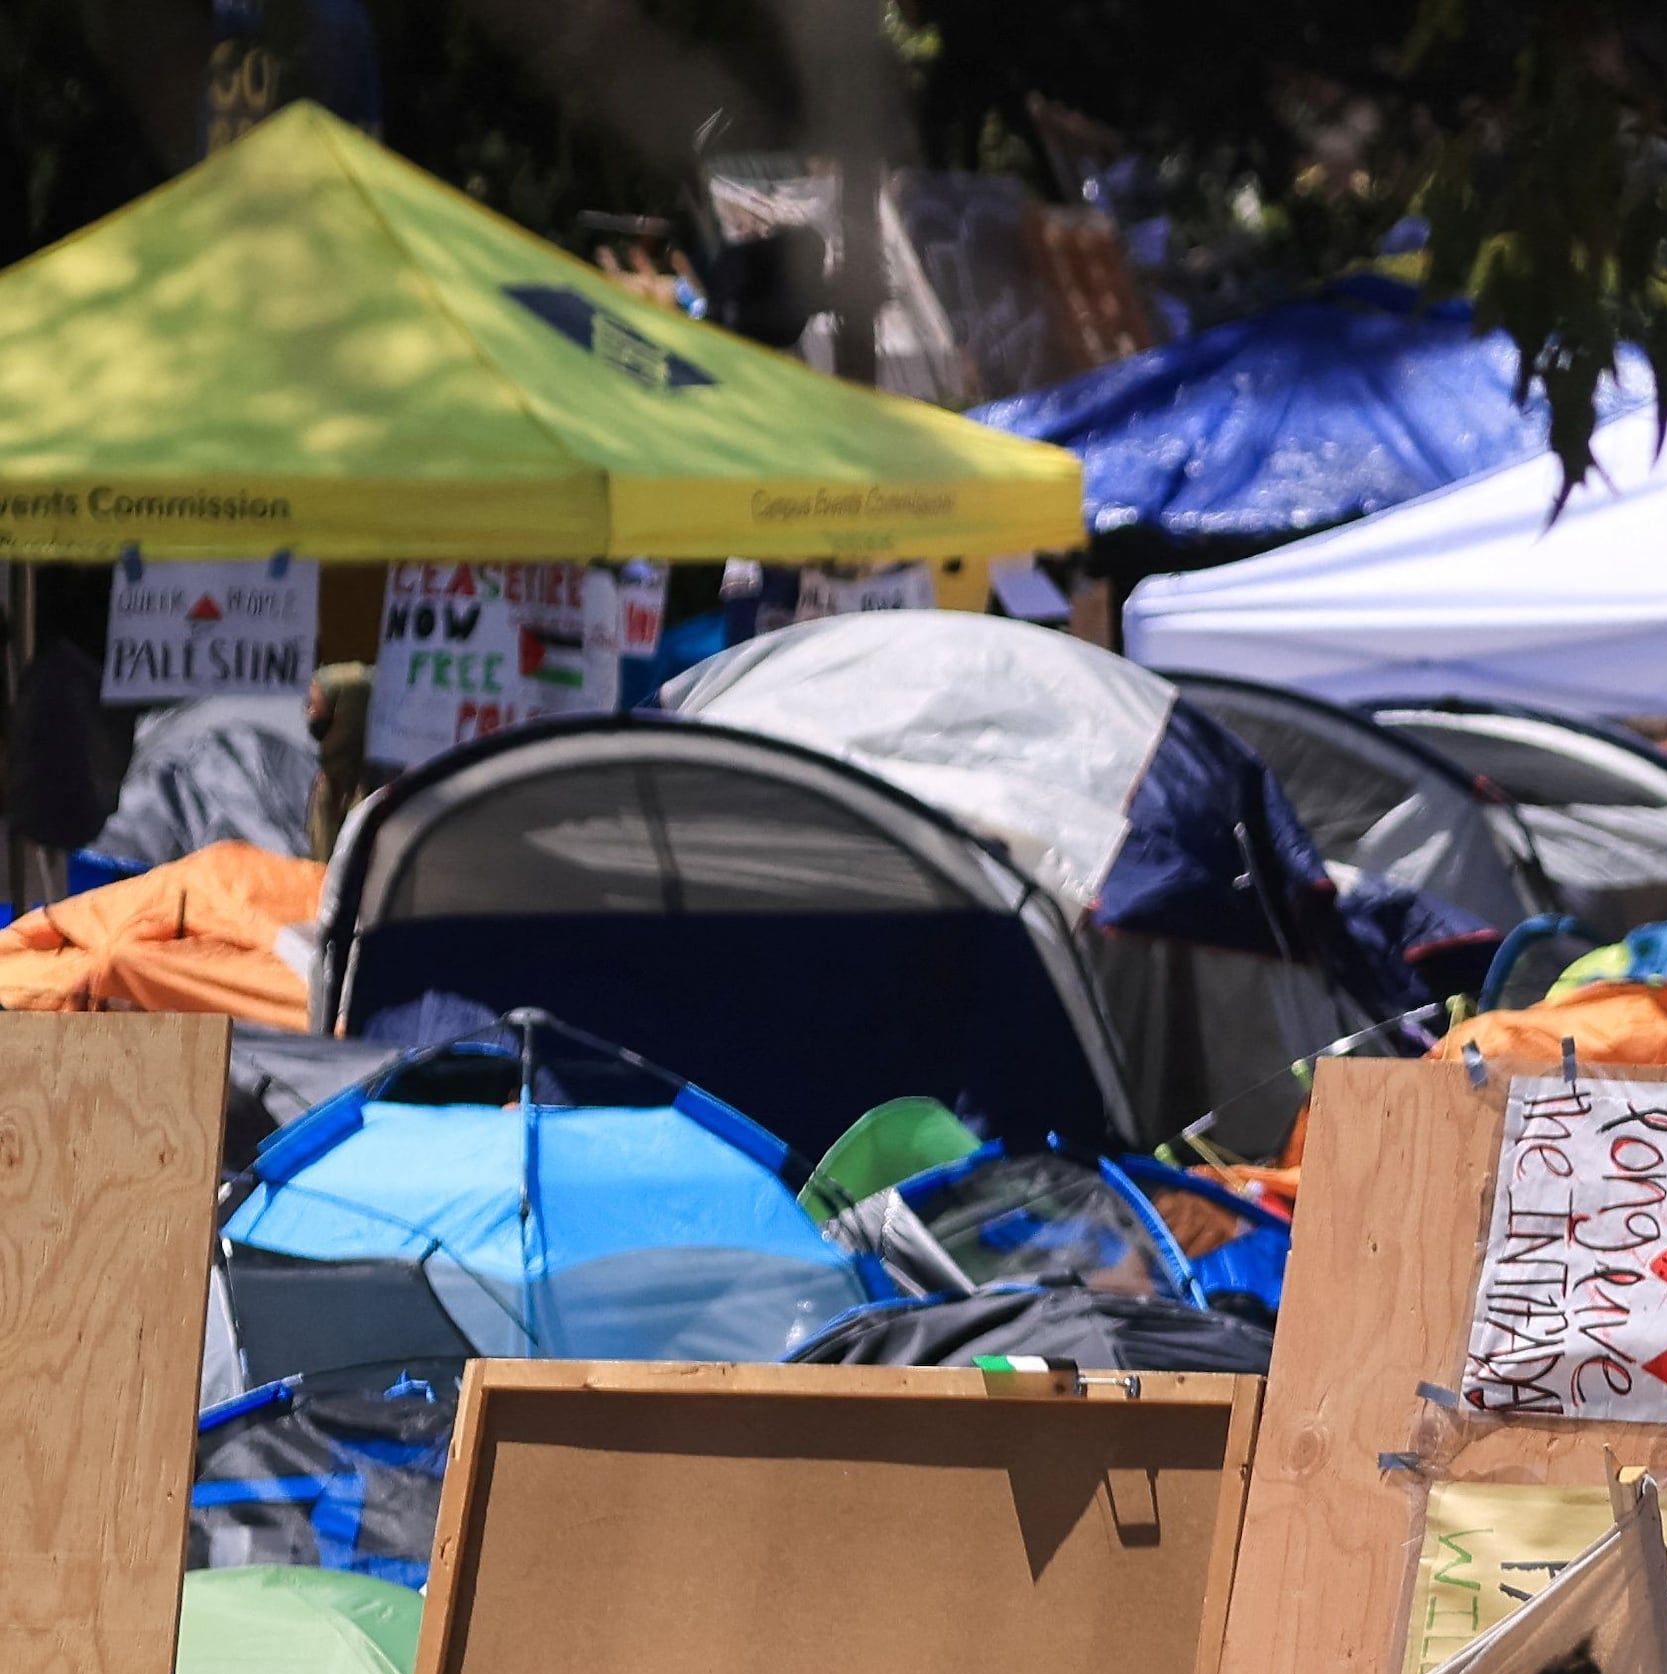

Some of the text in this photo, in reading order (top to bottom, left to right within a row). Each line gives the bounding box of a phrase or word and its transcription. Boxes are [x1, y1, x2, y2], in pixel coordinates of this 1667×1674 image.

[88, 486, 291, 522] Commission
[385, 600, 481, 641] NOW
[112, 636, 306, 684] PALESTINE
[407, 651, 504, 693] FREE
